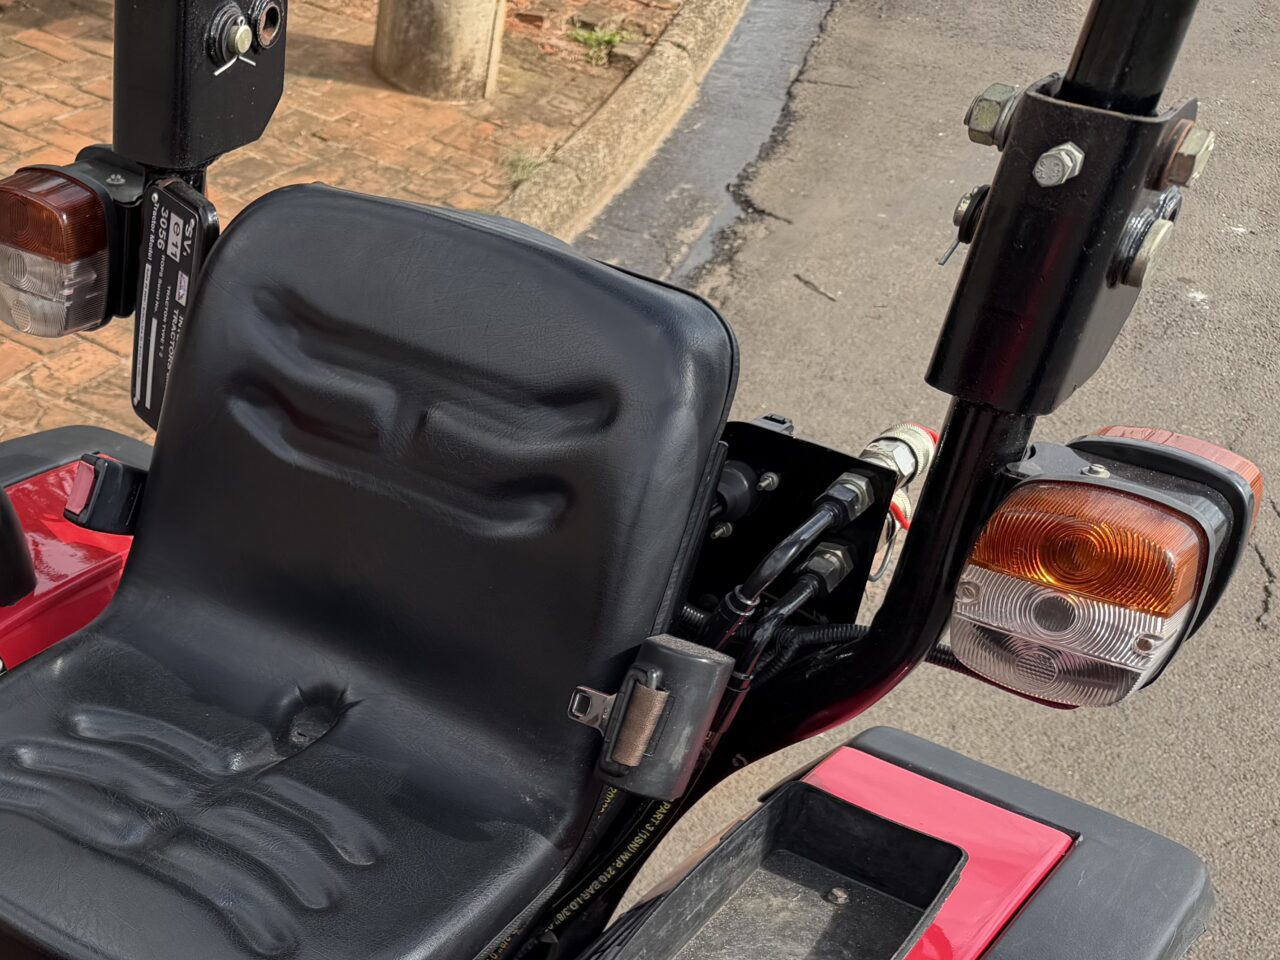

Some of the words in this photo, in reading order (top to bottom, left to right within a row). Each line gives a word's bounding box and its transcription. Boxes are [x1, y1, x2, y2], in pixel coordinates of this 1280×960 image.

[151, 203, 159, 233] Tractor
[157, 206, 168, 251] 3056
[147, 235, 155, 260] Model
[163, 286, 172, 323] TRACTOR
[651, 801, 671, 825] PART
[645, 823, 655, 831] 3
[627, 830, 650, 853] (1SN)
[598, 866, 616, 882] 210
[580, 880, 601, 899] BAR
